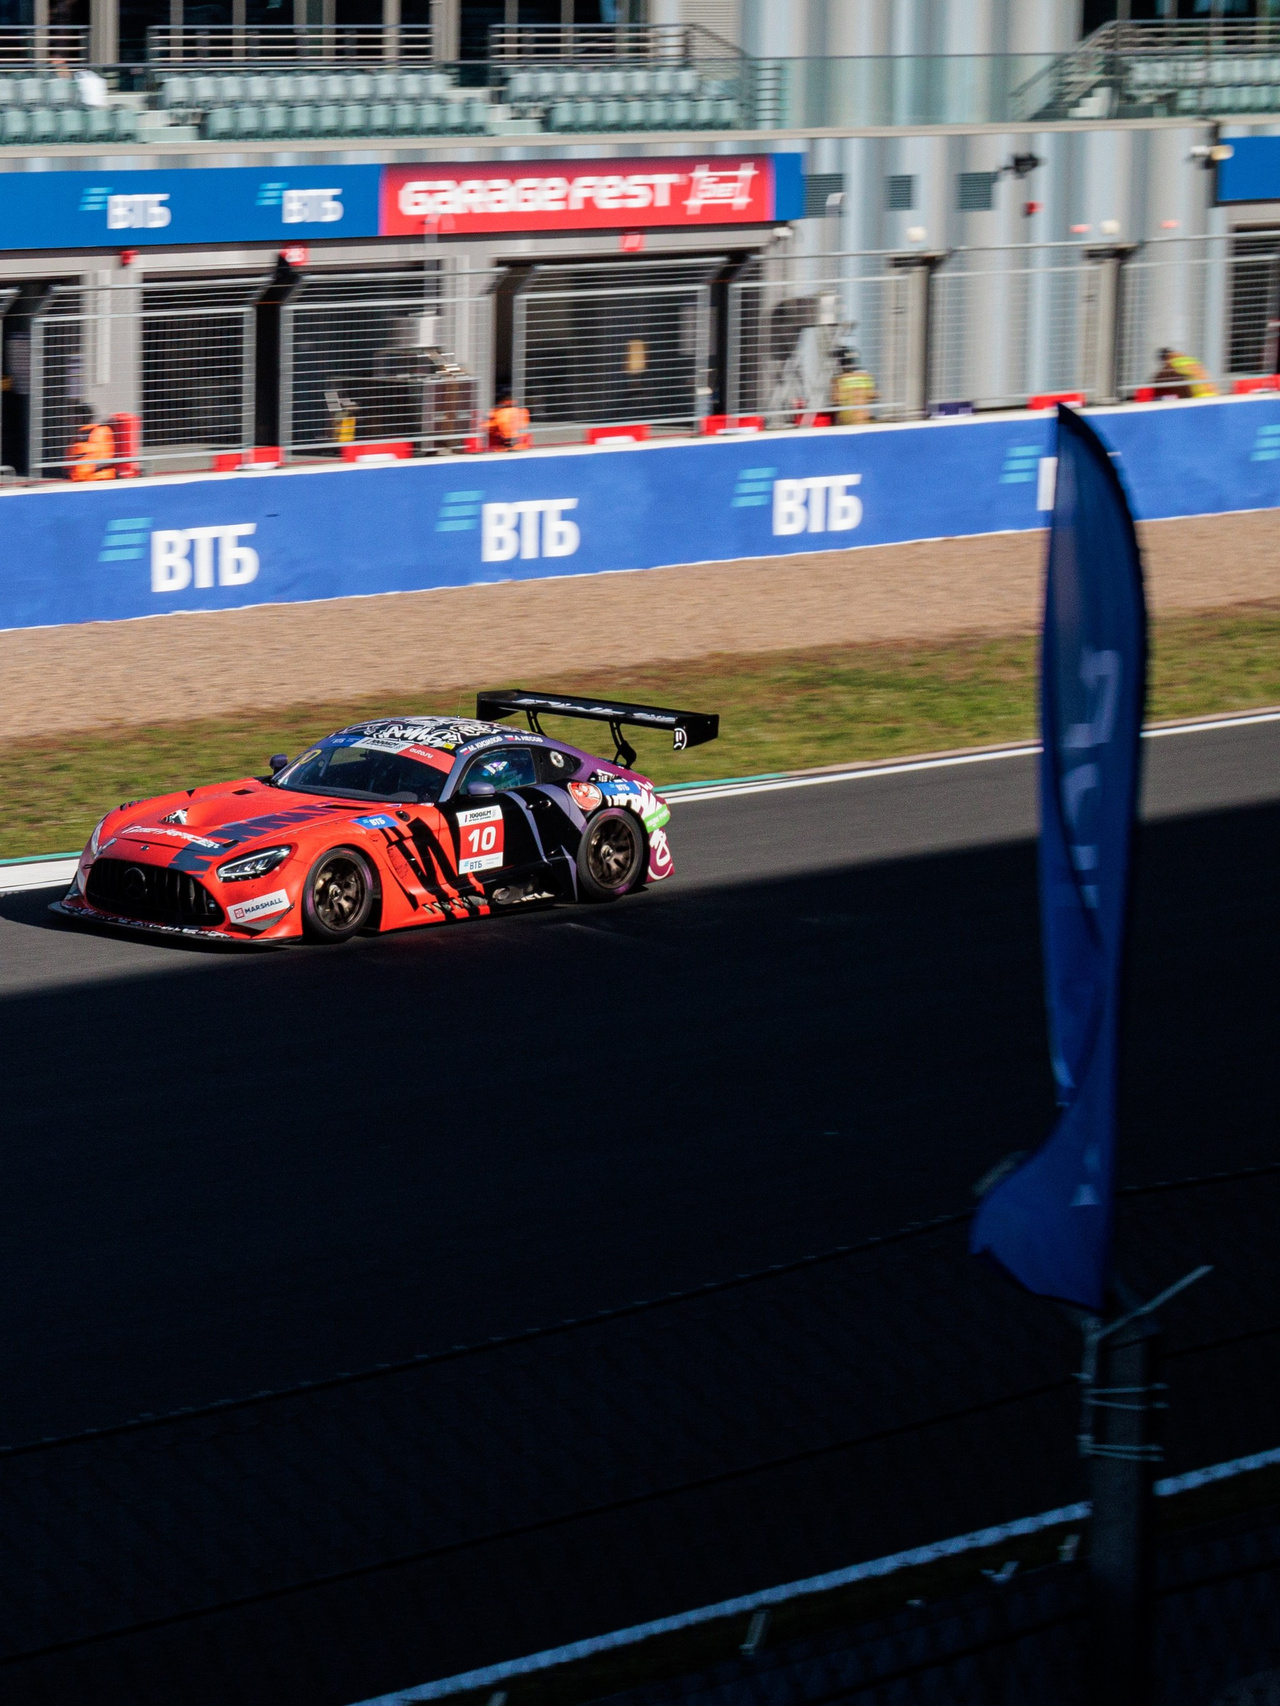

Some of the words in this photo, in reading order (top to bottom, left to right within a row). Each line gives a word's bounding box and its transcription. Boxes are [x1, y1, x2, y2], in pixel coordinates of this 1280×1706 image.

[107, 193, 171, 229] ВТБ
[282, 188, 344, 223] ВТБ
[772, 474, 863, 536] ВТБ
[481, 498, 581, 562] ВТБ
[150, 523, 260, 592] ВТБ
[409, 747, 434, 759] auto.ru
[369, 817, 386, 826] ВТБ
[468, 825, 497, 853] 10
[469, 860, 483, 870] ВТБ
[244, 897, 283, 915] MARSHALL
